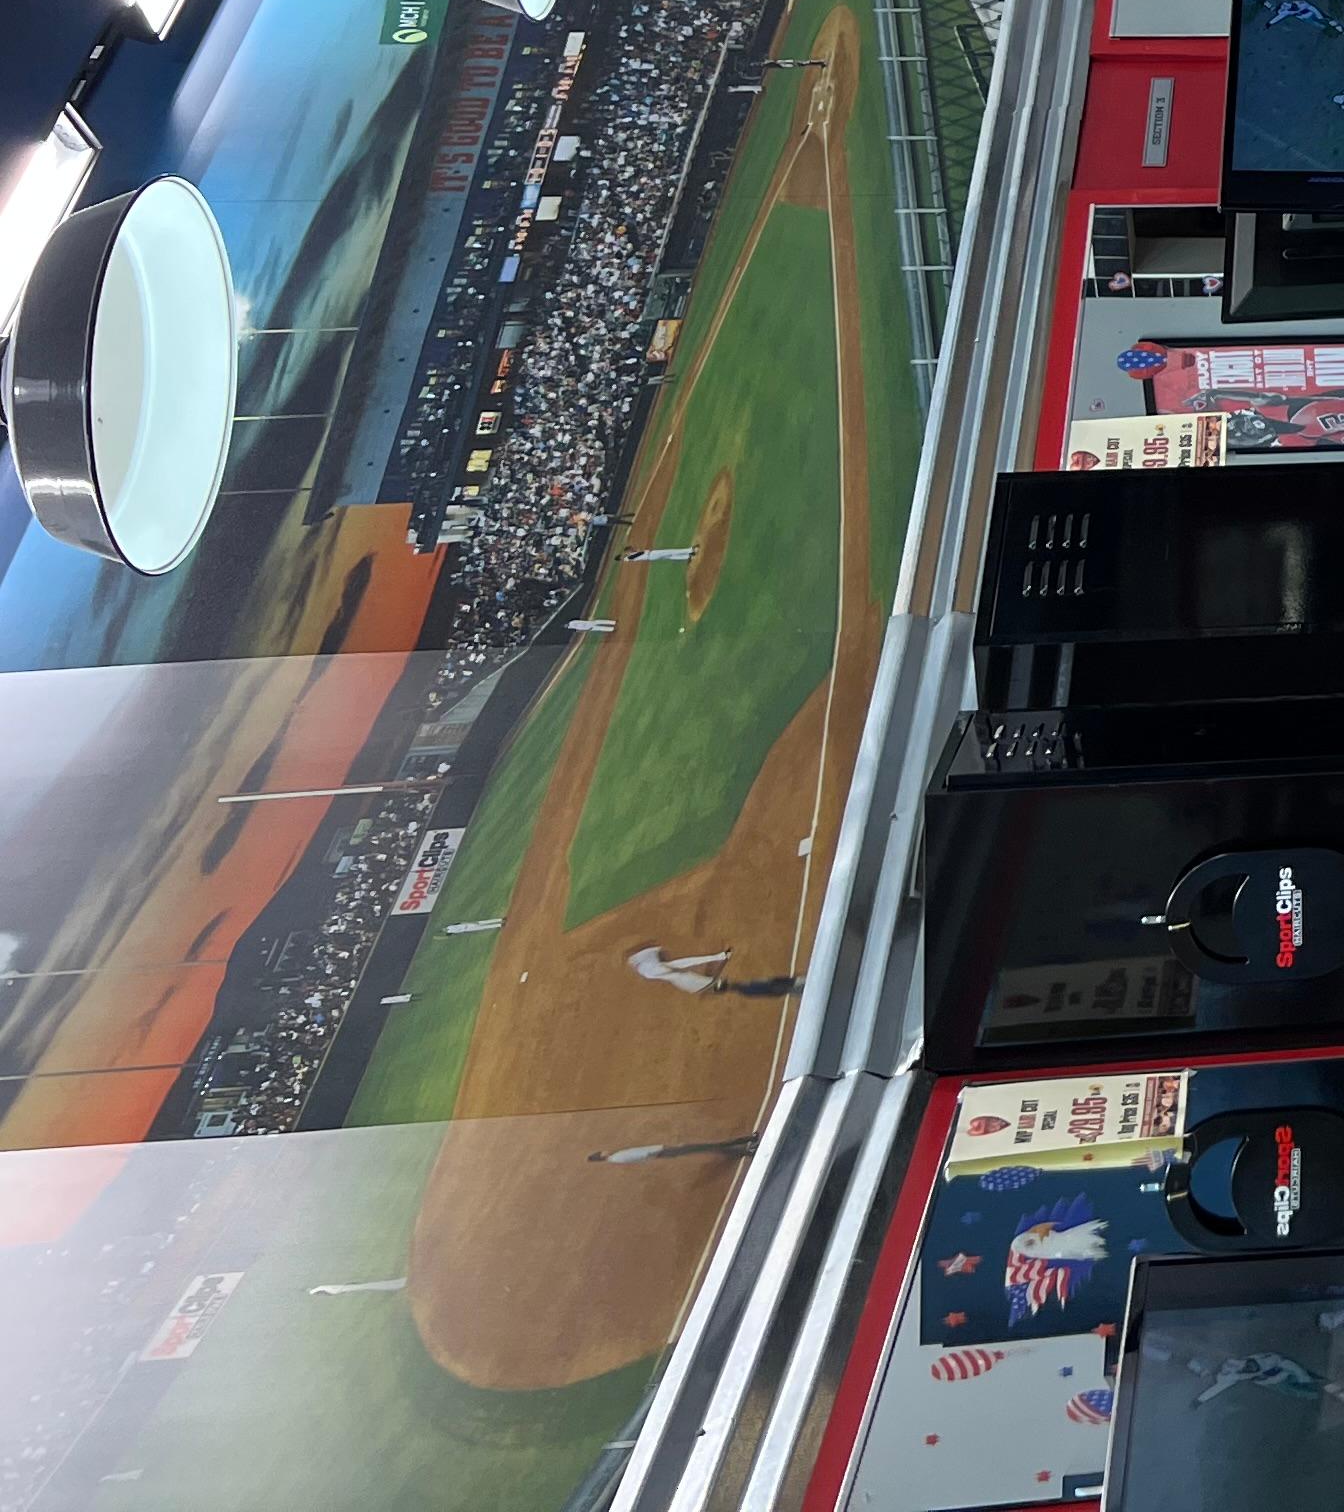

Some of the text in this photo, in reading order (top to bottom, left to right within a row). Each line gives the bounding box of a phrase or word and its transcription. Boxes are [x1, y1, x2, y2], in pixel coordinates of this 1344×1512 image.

[428, 14, 513, 192] IT'S GOOD TO BE A
[1151, 106, 1165, 146] SECTION
[1142, 437, 1170, 468] 9.95
[399, 832, 449, 910] SportClips
[1275, 867, 1295, 968] SportClips
[1019, 1099, 1040, 1112] CUT
